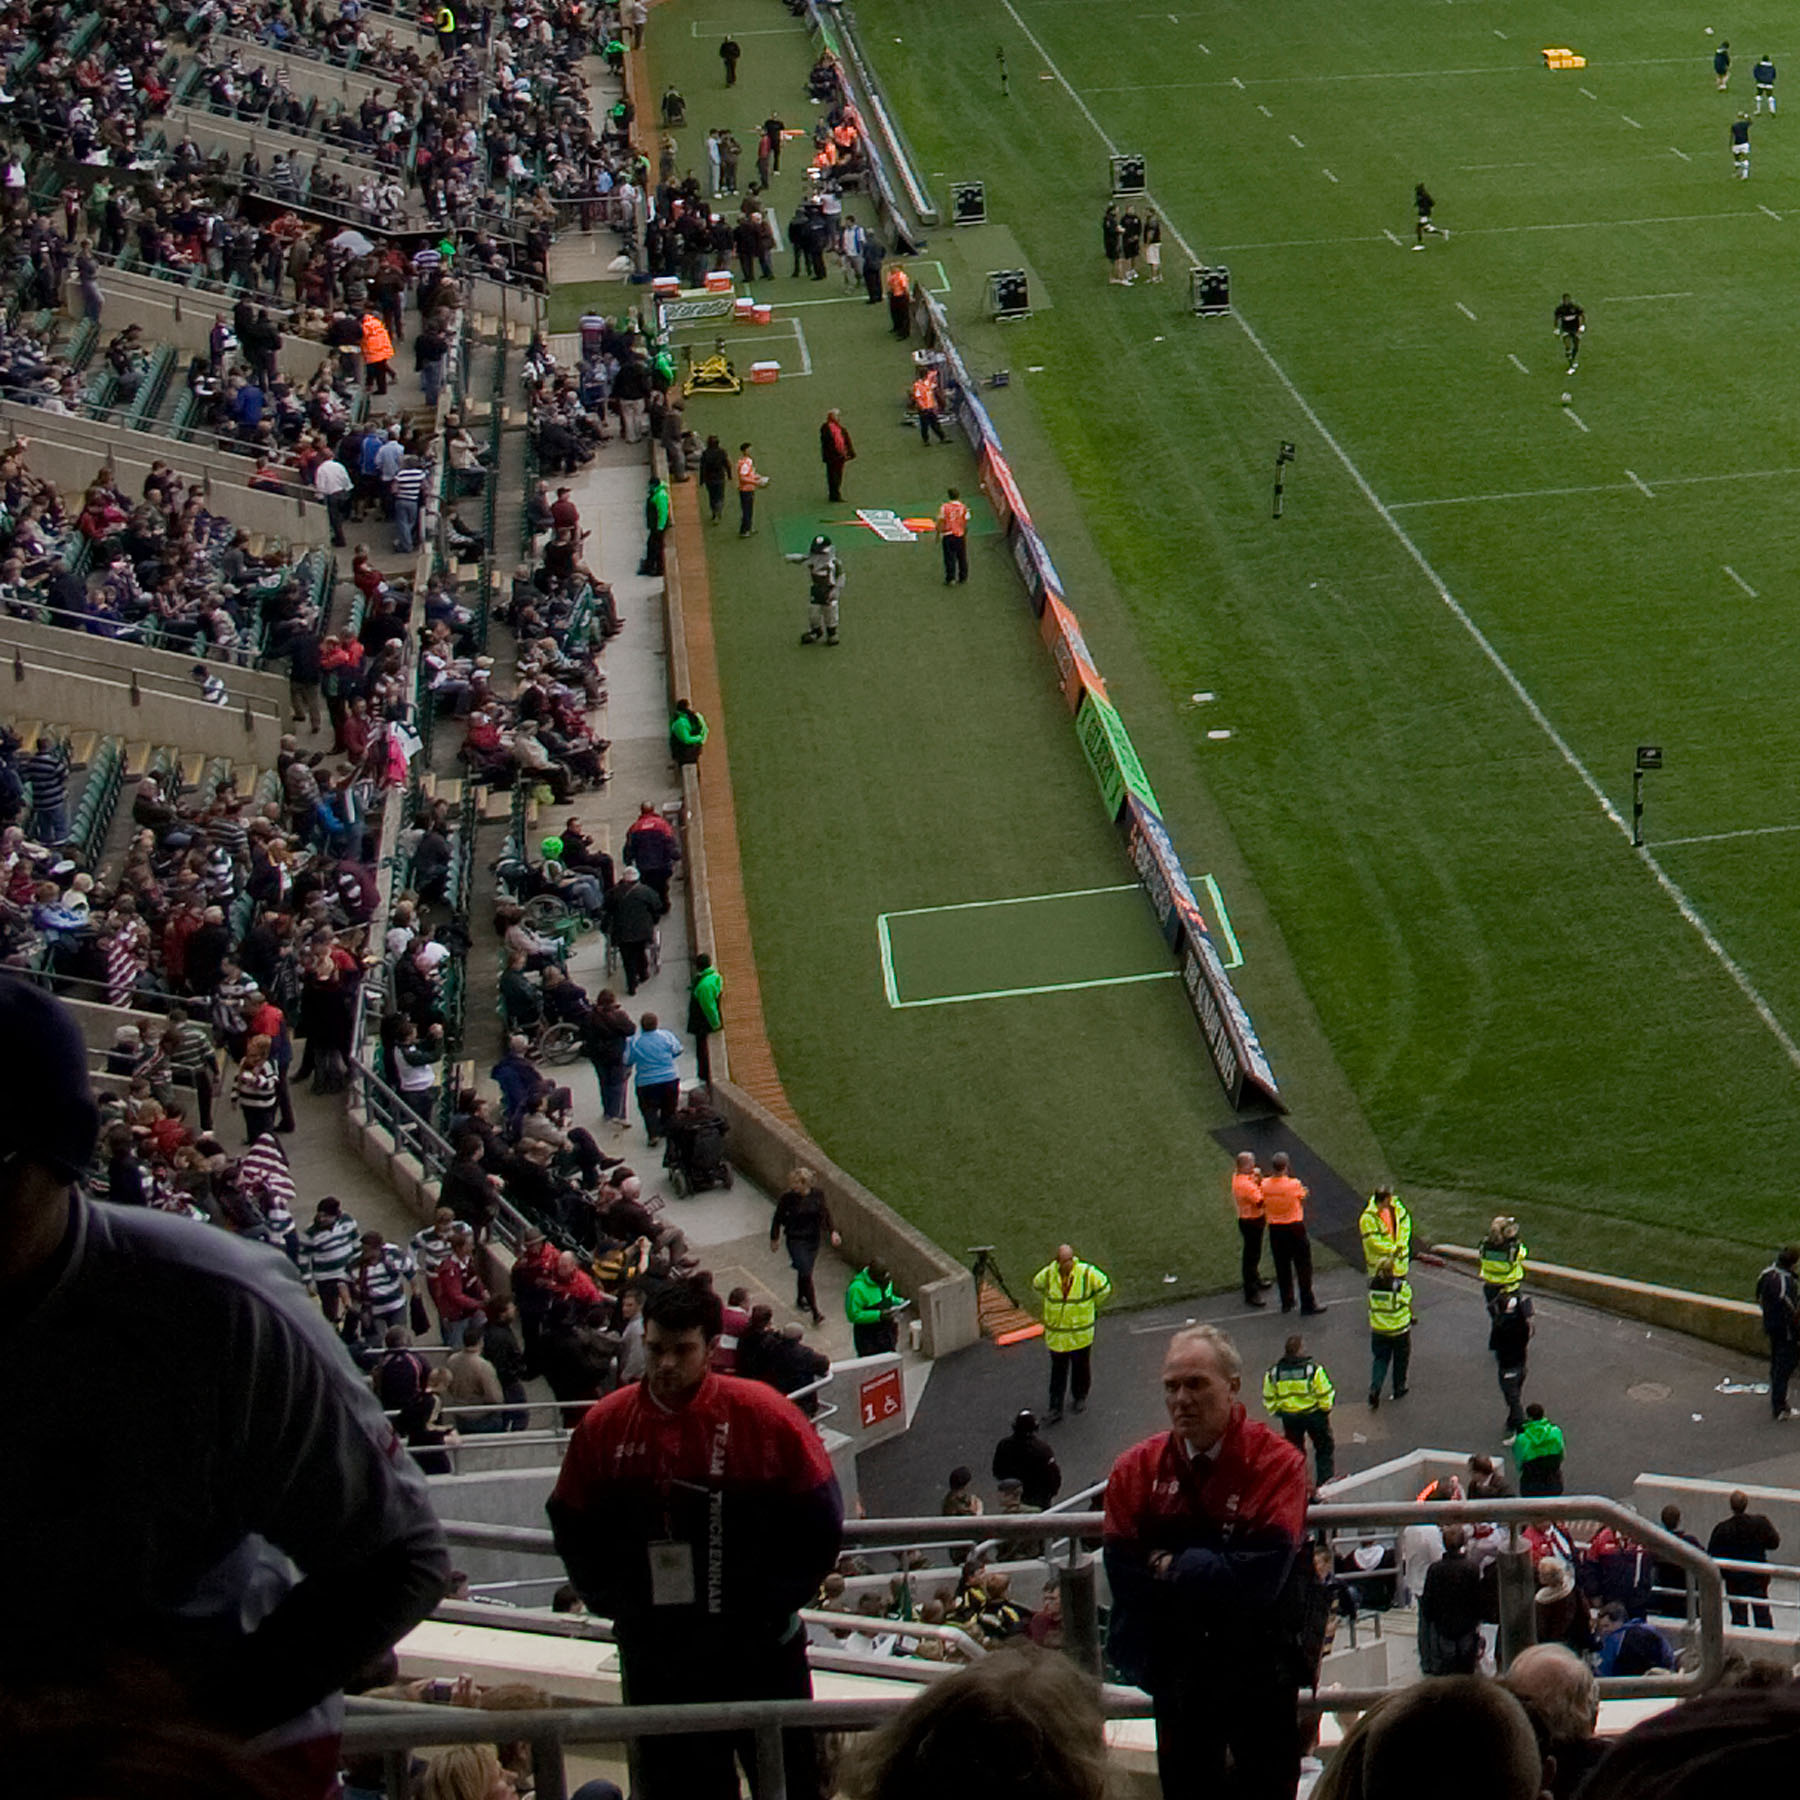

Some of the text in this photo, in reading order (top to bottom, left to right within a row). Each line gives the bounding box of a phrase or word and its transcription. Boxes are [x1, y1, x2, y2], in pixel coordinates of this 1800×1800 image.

[864, 1403, 876, 1424] 1
[708, 1422, 730, 1614] TEAM TWICKENHAM
